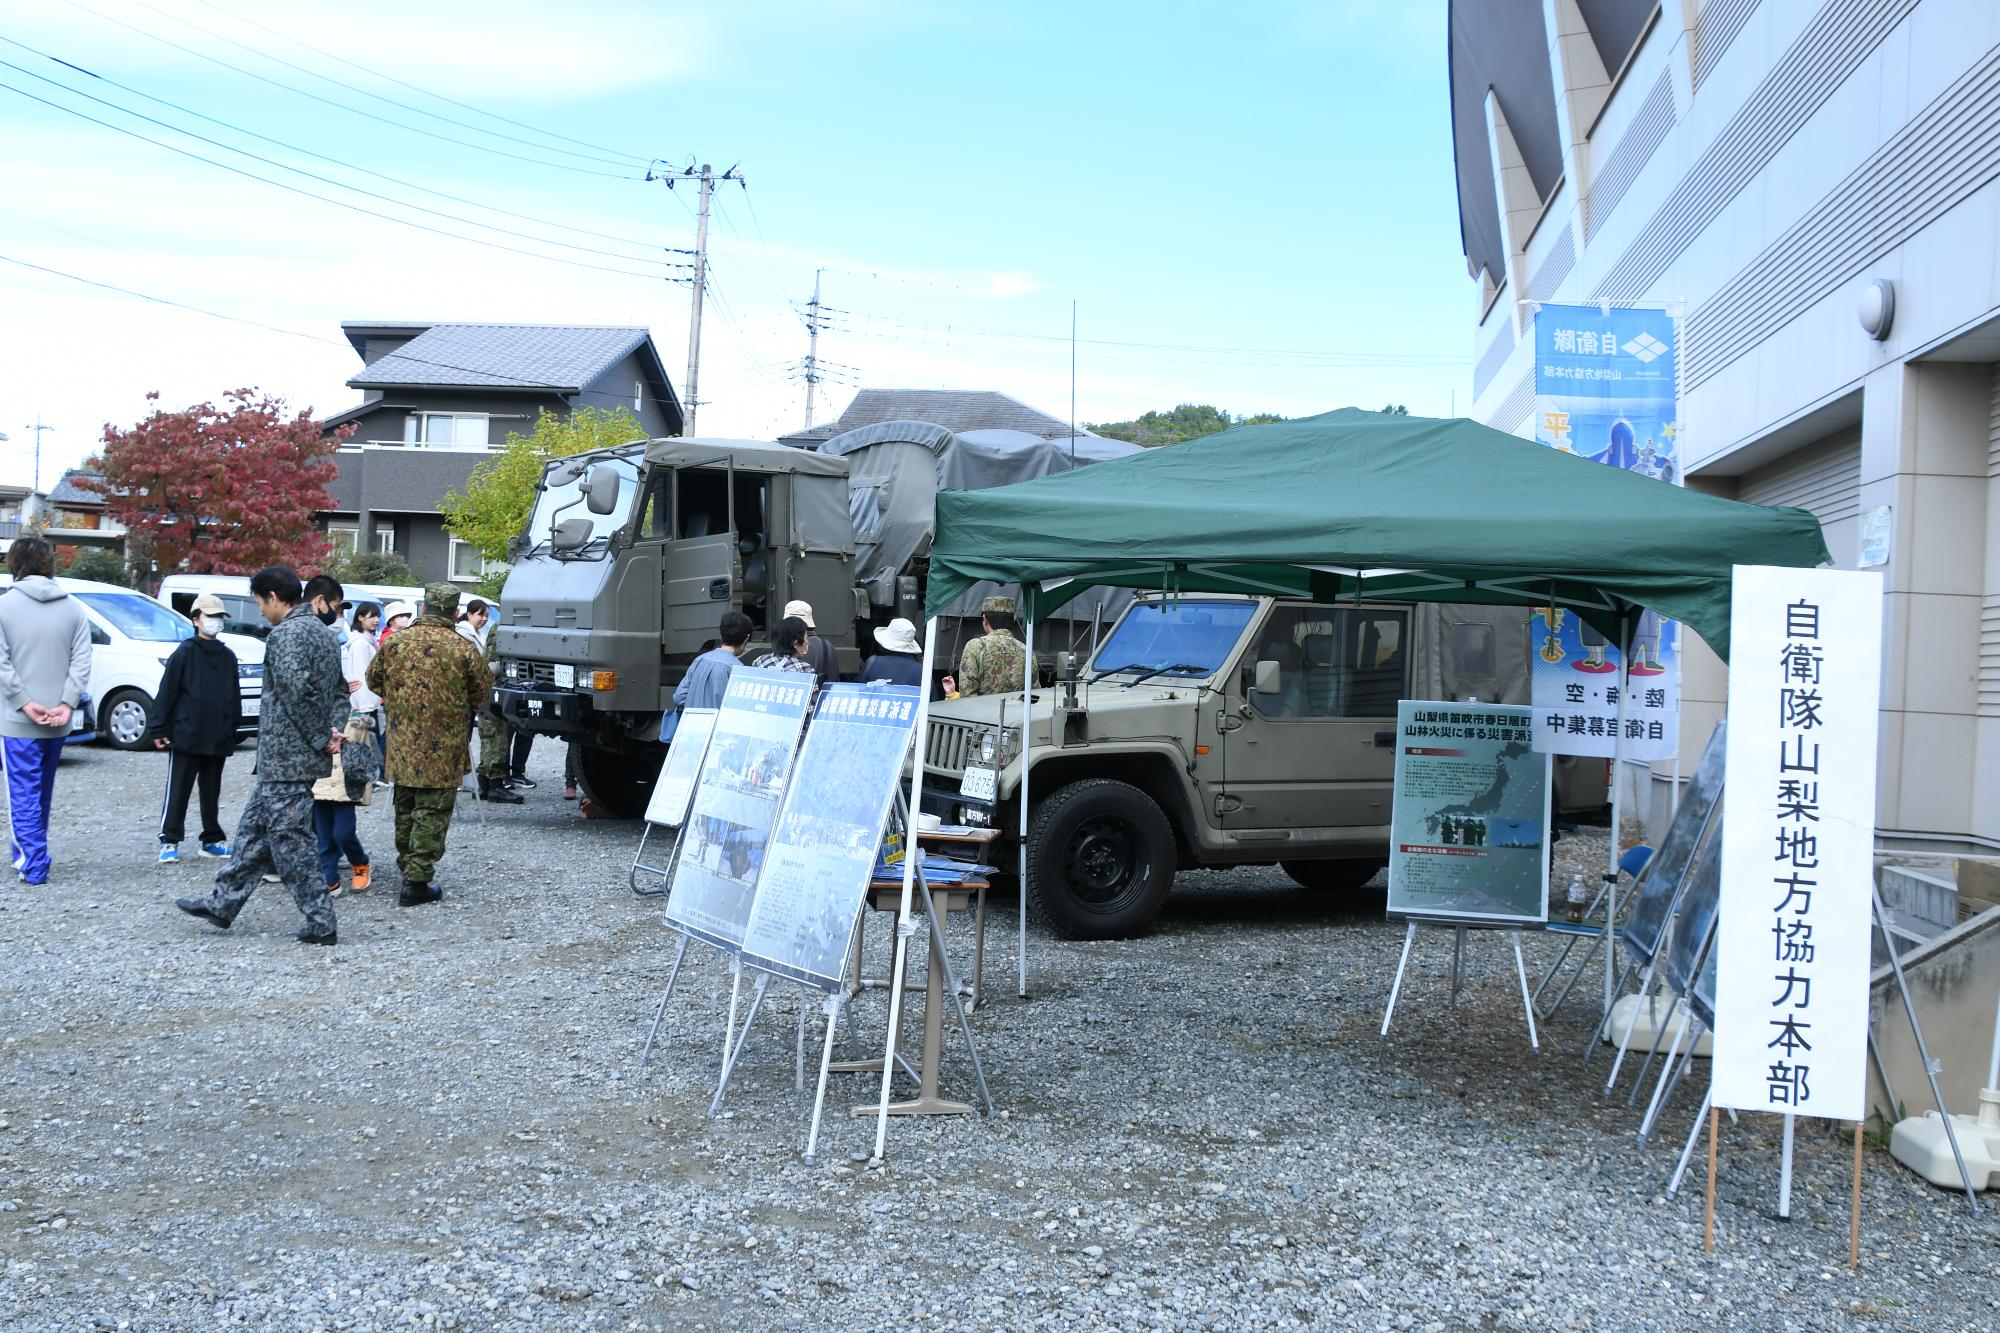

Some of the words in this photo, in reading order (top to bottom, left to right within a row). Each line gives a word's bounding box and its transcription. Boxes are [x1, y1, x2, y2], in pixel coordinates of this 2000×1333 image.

[820, 696, 912, 721] 山梨県豪雪災害派遣
[1414, 711, 1531, 728] 山梨県笛吹市春日居町
[1405, 725, 1532, 742] 山林火災に係る災害派
[1766, 598, 1824, 1107] 自衛隊山梨地方協力本部
